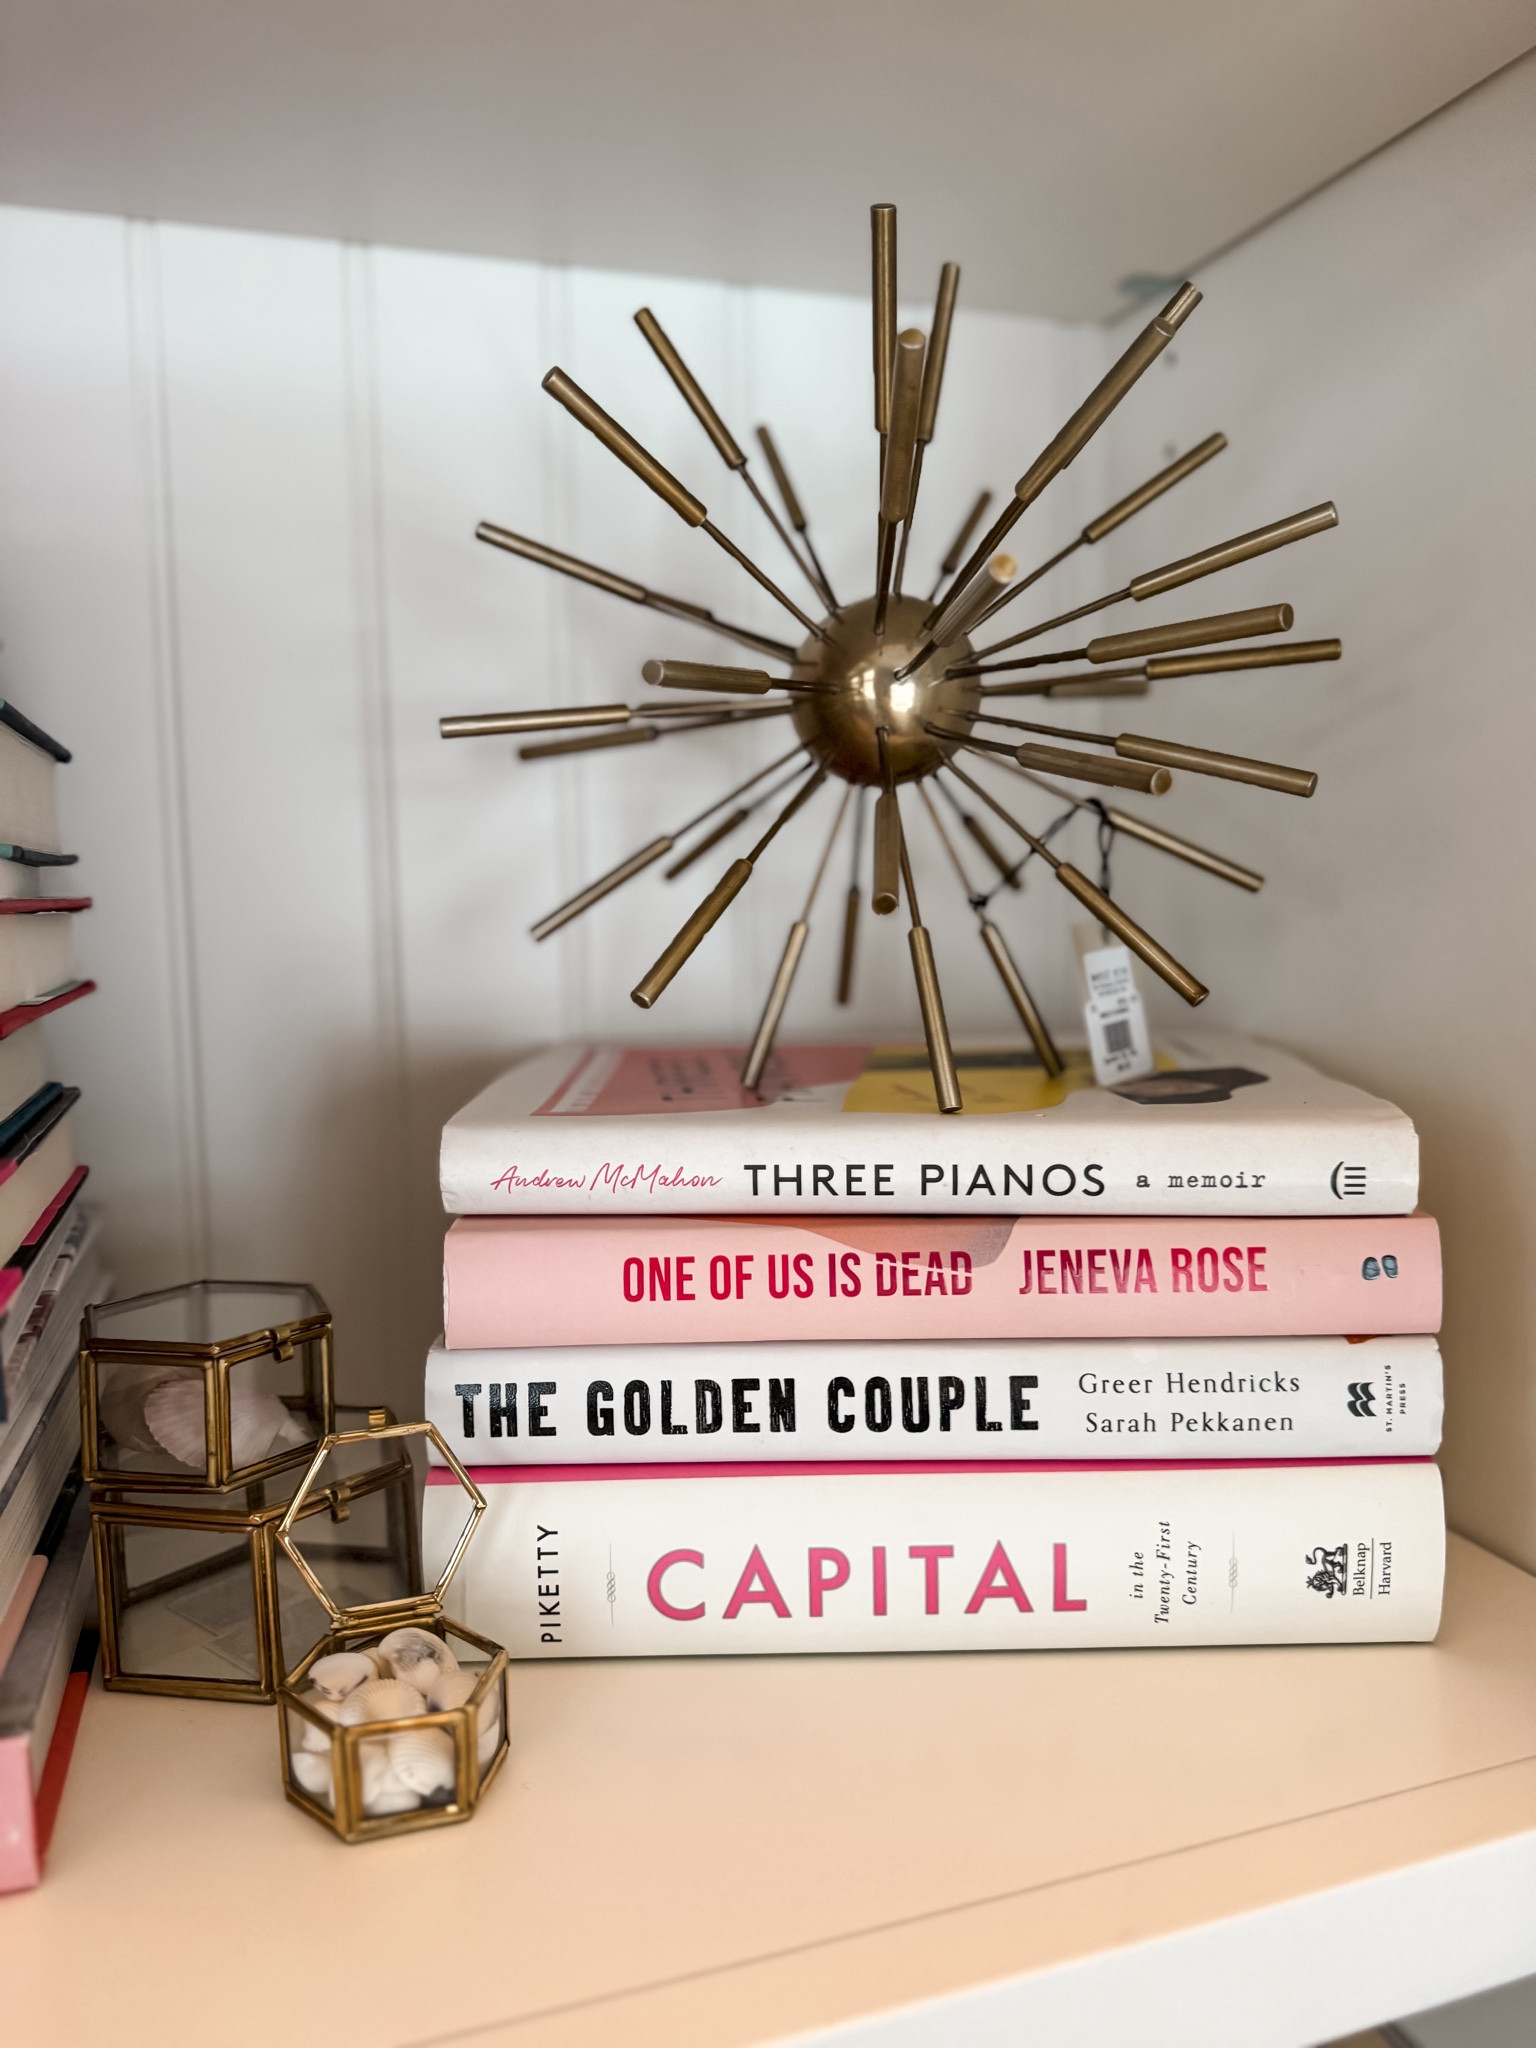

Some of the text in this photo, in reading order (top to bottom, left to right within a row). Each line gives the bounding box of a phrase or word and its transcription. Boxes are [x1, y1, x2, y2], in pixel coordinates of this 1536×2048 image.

[489, 1162, 723, 1195] Andrew McMahon
[743, 1163, 1105, 1197] THREE PIANOS
[1136, 1171, 1266, 1189] a memoir
[622, 1250, 973, 1303] ONE OF US IS DEAD
[1019, 1246, 1268, 1295] JENEVA ROSE
[454, 1375, 1039, 1439] THE GOLDEN COUPLE
[1078, 1370, 1300, 1394] Greer Hendricks
[1384, 1364, 1393, 1433] ST. MARTIN'S
[1399, 1383, 1407, 1415] PRESS
[1086, 1411, 1293, 1433] Sarah Pekkanen
[536, 1524, 563, 1643] PIKETTY
[646, 1540, 1088, 1622] CAPITAL
[1128, 1551, 1144, 1599] in the
[1153, 1521, 1175, 1624] Twenty-First
[1181, 1541, 1202, 1605] Century
[1352, 1542, 1371, 1597] Belknap
[1377, 1541, 1392, 1595] Harvard
